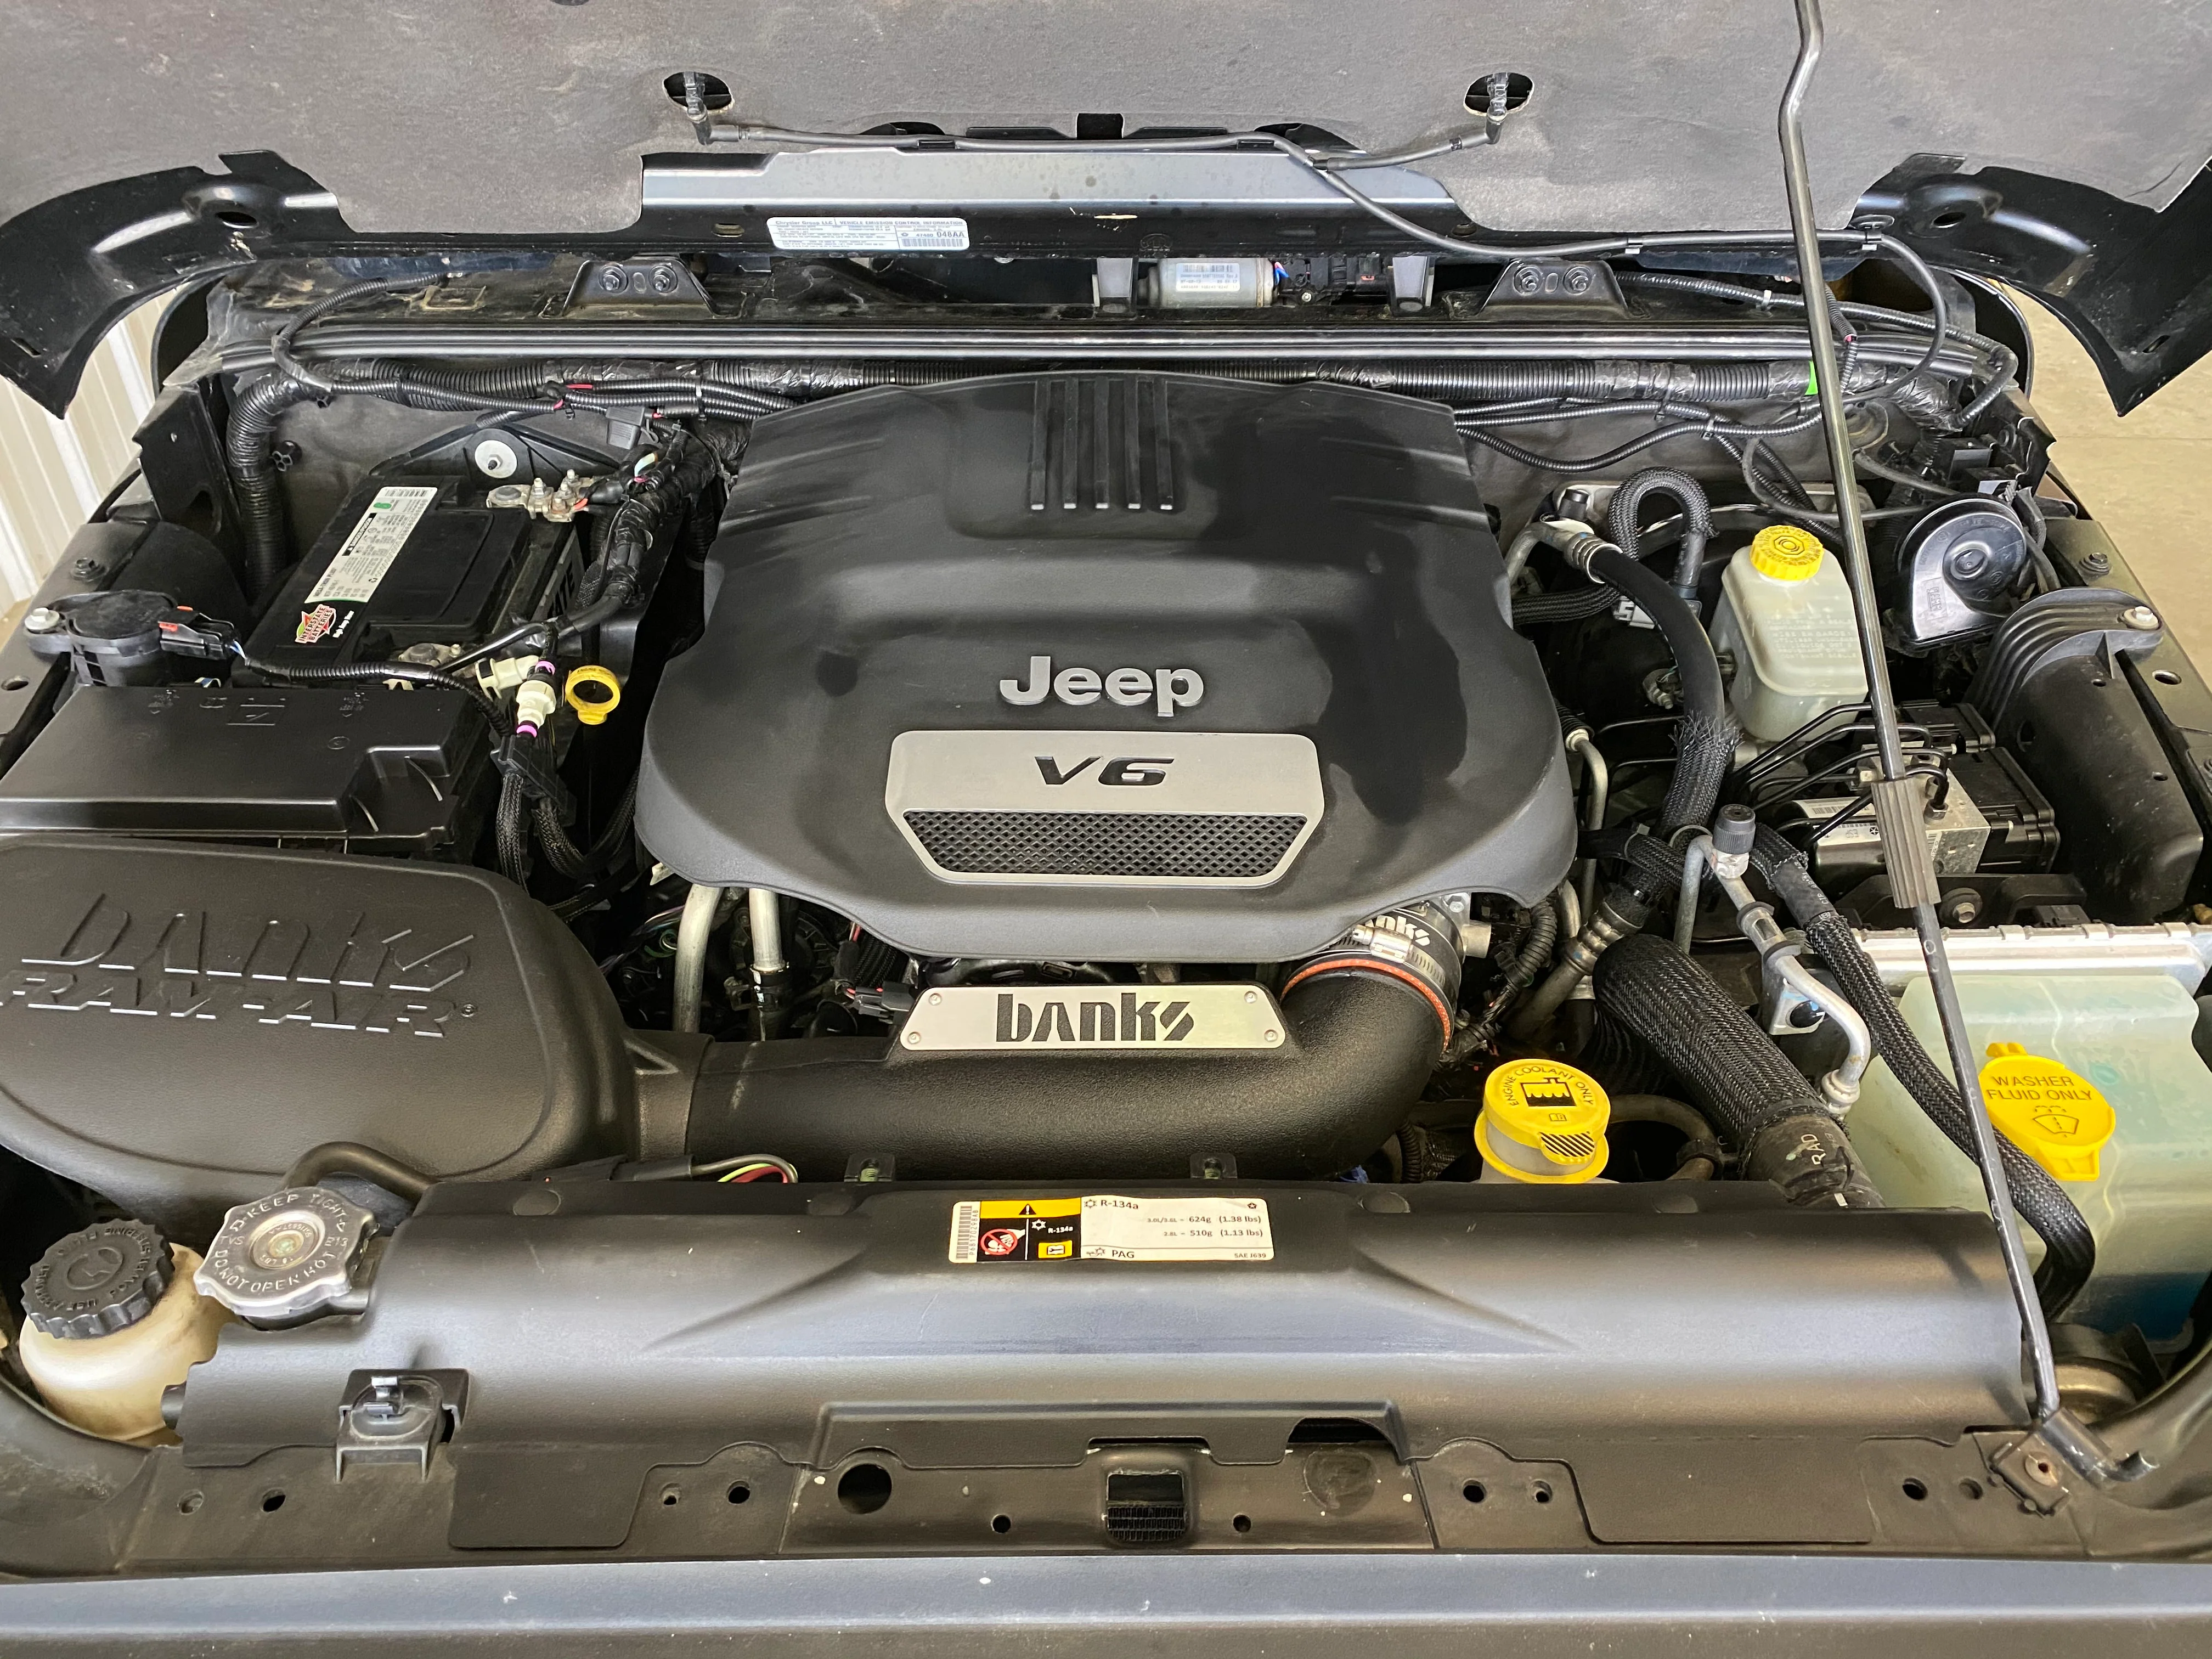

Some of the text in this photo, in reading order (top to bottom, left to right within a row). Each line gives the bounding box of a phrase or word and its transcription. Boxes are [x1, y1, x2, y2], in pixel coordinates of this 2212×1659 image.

[298, 606, 326, 641] INTERSTATE
[309, 608, 333, 641] BATTERIES
[999, 656, 1204, 717] Jeep
[1034, 755, 1175, 786] V6
[996, 992, 1195, 1042] banks
[1503, 1065, 1594, 1106] ENGINE COOLANT ONLY
[1992, 1075, 2075, 1086] WASHER
[1985, 1089, 2093, 1101] FLUID ONLY
[1801, 1133, 1826, 1165] RAD
[247, 1194, 300, 1218] KEEP
[1101, 1199, 1138, 1210] R-134a
[1219, 1216, 1243, 1224] (1.38
[1245, 1215, 1261, 1224] lbs)
[219, 1235, 245, 1245] TVS
[1246, 1229, 1263, 1237] lbs)
[1111, 1250, 1135, 1258] PAG
[219, 1270, 250, 1289] NOT
[250, 1274, 299, 1293] OPEN
